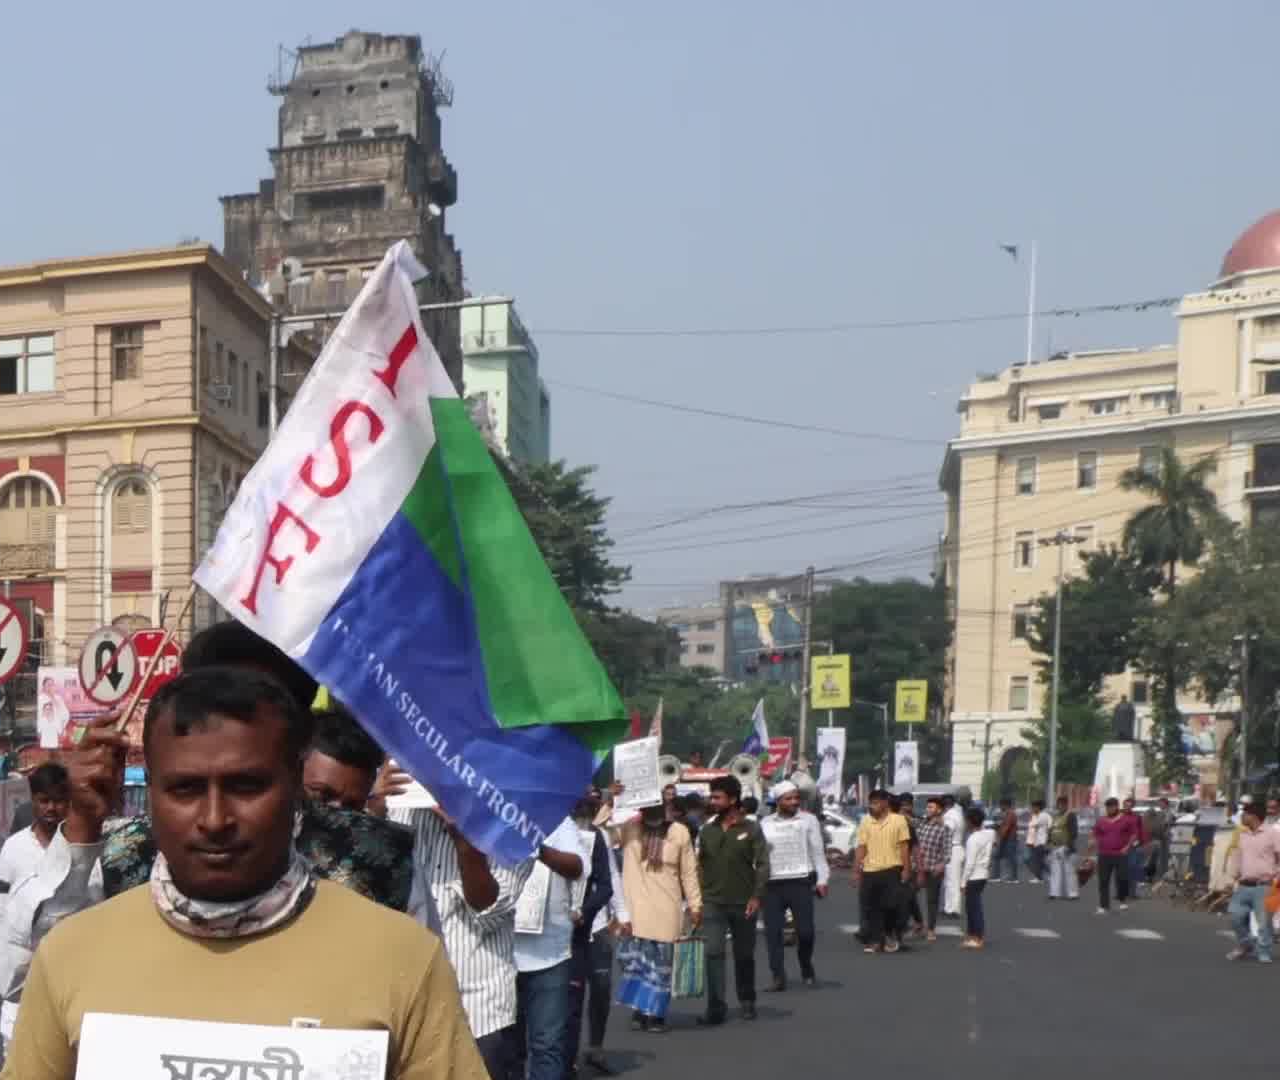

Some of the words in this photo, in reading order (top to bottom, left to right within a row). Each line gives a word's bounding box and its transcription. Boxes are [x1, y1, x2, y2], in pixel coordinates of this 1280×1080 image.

[240, 321, 418, 615] ISF
[138, 656, 178, 676] TOP
[395, 691, 476, 788] SECULAR
[475, 779, 547, 853] FRONT
